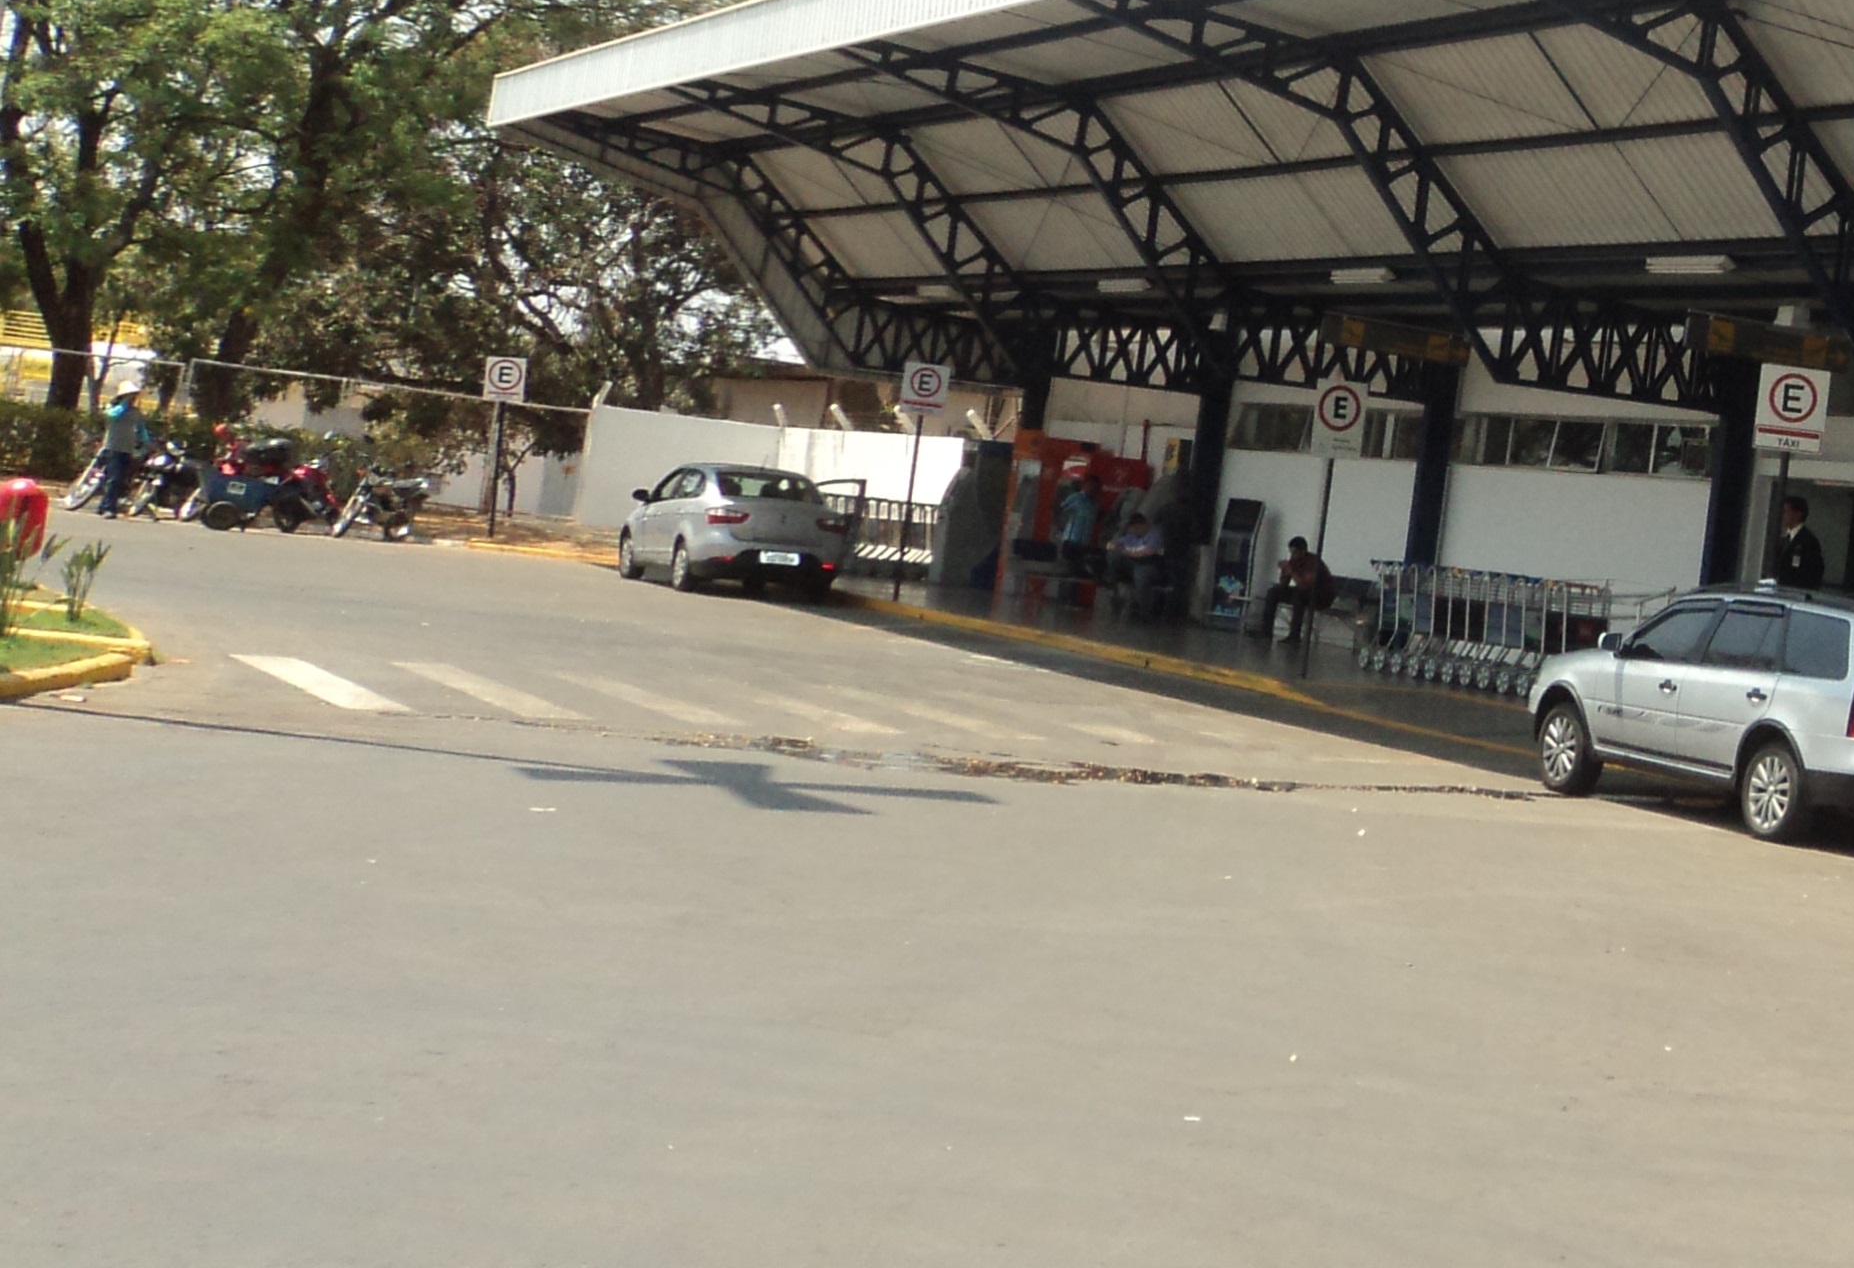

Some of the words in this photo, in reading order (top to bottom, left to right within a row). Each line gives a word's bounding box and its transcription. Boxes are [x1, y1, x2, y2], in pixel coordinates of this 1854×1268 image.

[499, 366, 513, 383] E
[918, 373, 933, 392] E
[1333, 396, 1348, 419] E
[1782, 383, 1805, 414] E
